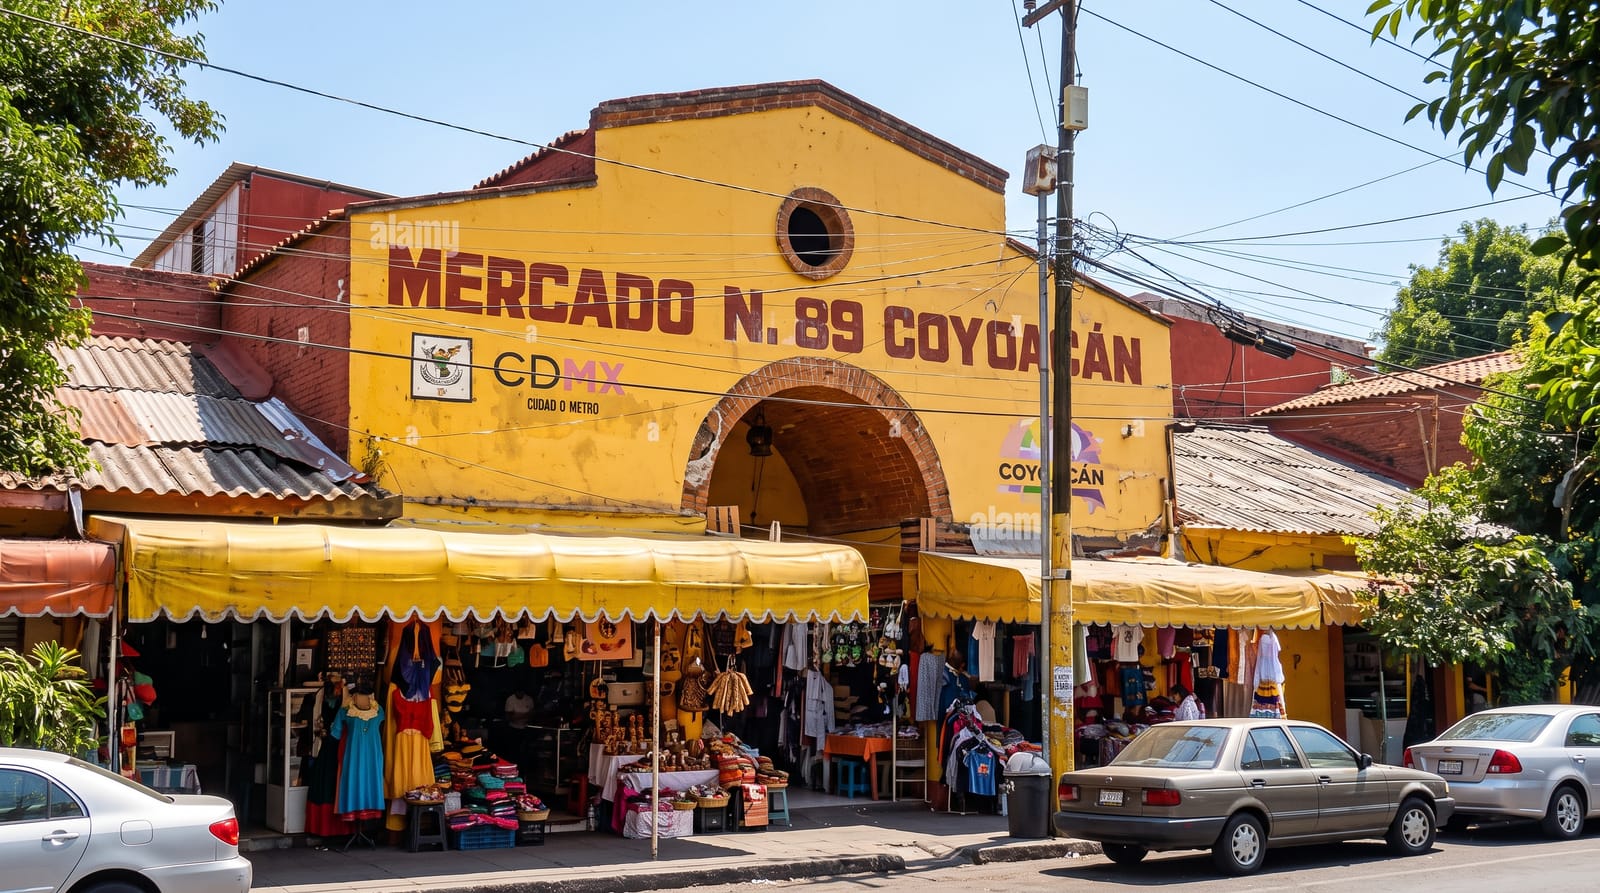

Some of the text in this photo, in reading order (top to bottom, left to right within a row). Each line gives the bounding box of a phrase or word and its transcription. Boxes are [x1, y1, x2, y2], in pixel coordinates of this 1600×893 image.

[388, 244, 695, 336] MERCADO
[724, 285, 778, 345] N.
[795, 296, 864, 354] 89
[493, 351, 625, 396] CDMX
[527, 397, 600, 415] CUDAD O METRO
[998, 462, 1105, 486] COYCÁN
